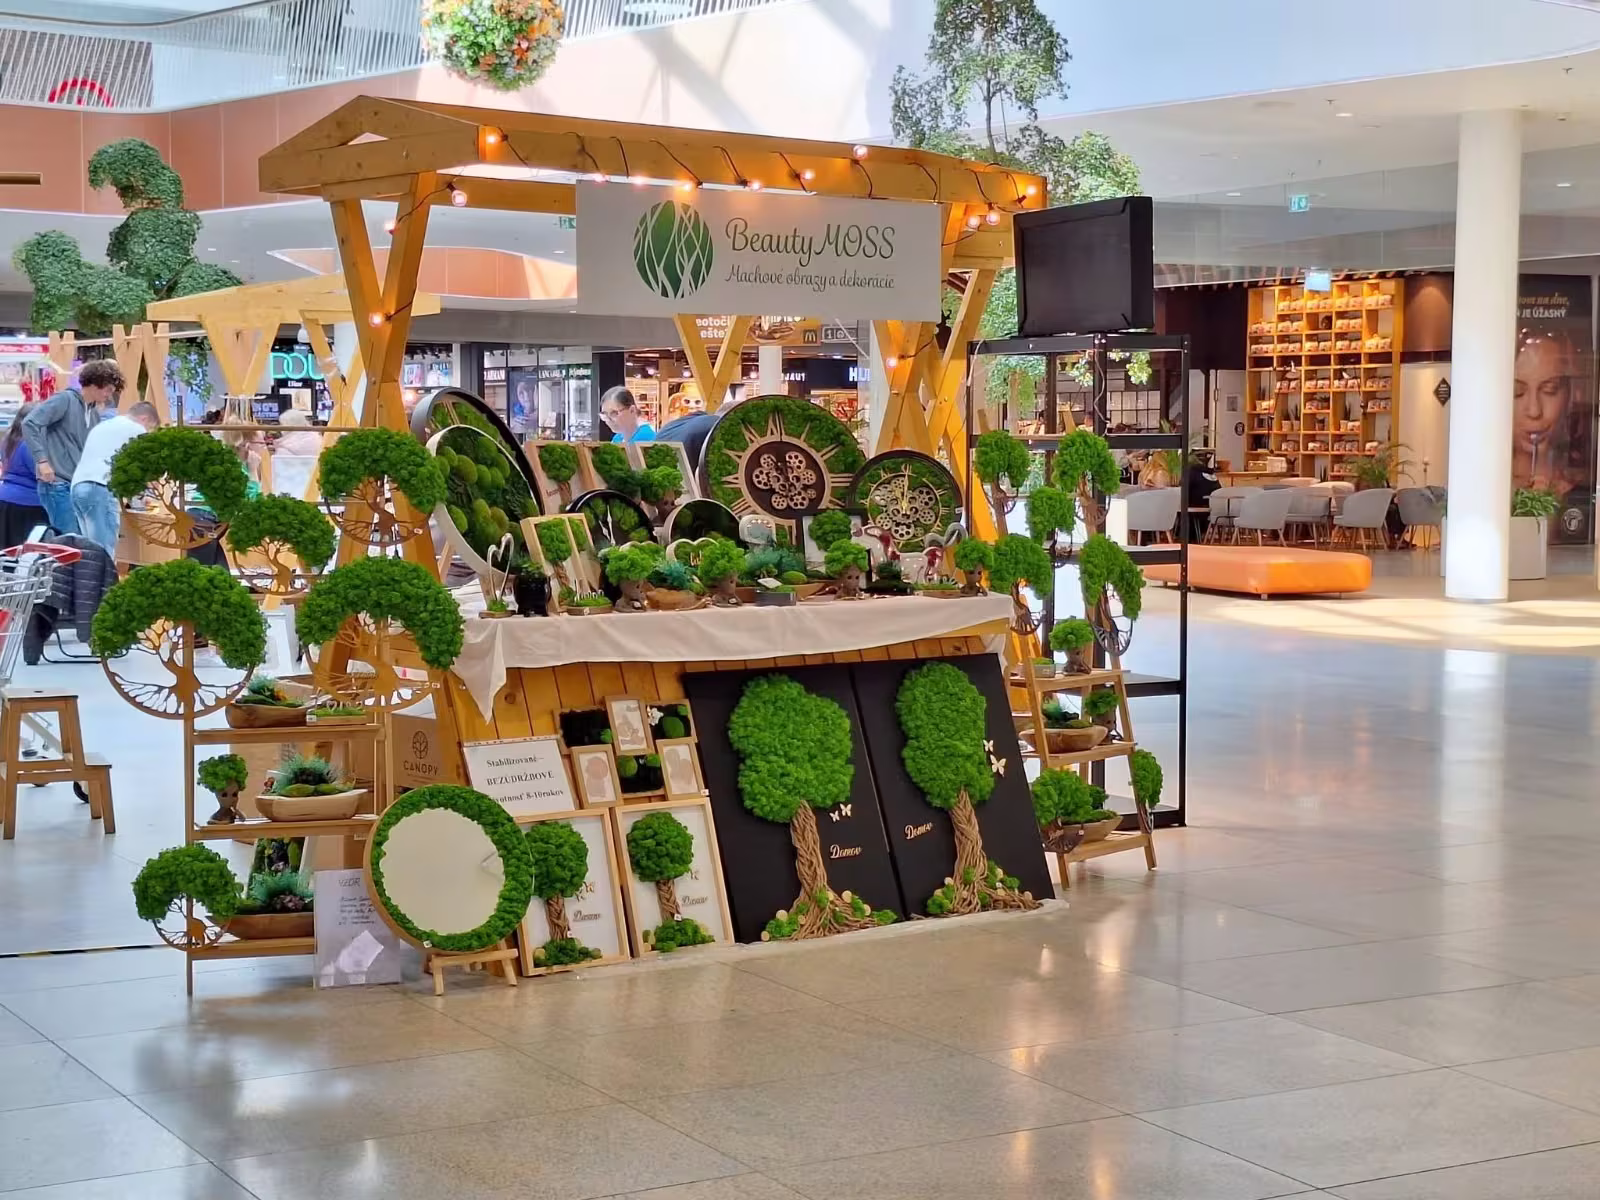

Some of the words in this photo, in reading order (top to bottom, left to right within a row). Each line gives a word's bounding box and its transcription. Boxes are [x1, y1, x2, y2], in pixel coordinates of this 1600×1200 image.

[725, 216, 814, 268] Beauty
[814, 223, 895, 259] MOSS
[725, 264, 783, 285] Machové
[786, 267, 827, 292] obrazy
[829, 276, 837, 286] a
[839, 268, 895, 288] dekorácie
[1532, 306, 1567, 318] ÚŽASNÝ
[403, 760, 438, 776] CANOPY
